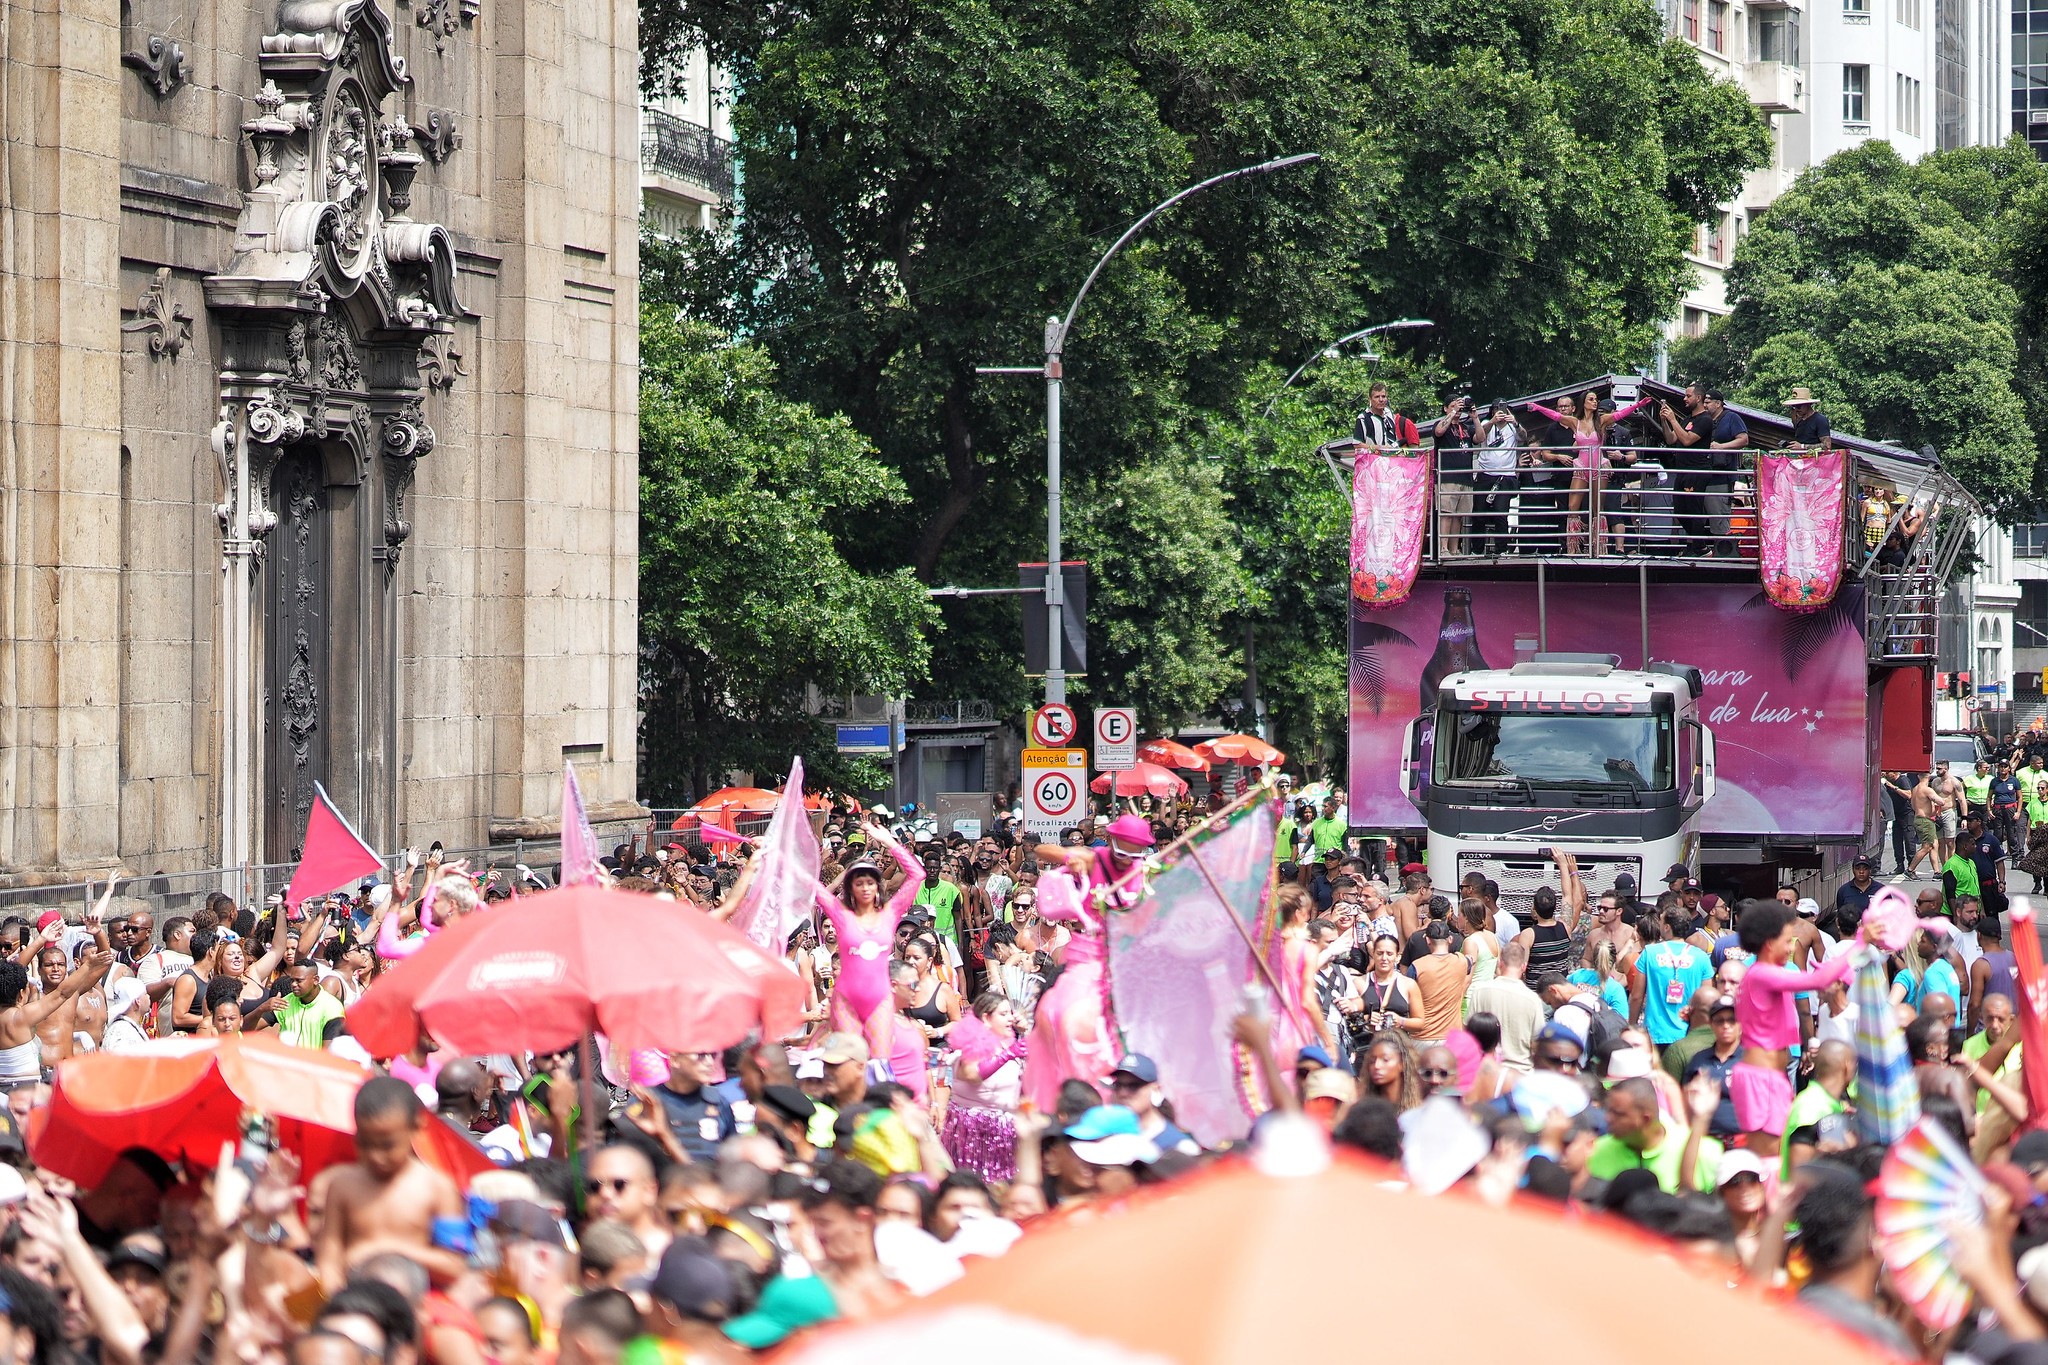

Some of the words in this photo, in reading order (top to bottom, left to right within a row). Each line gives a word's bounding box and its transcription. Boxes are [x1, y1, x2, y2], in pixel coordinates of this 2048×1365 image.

[1470, 691, 1632, 712] STILLOS
[1709, 693, 1740, 724] de
[1749, 691, 1797, 723] lua
[1110, 718, 1120, 736] E
[1026, 754, 1066, 764] Atenção
[1042, 782, 1067, 800] 60
[1028, 819, 1077, 827] Fiscalizaçã
